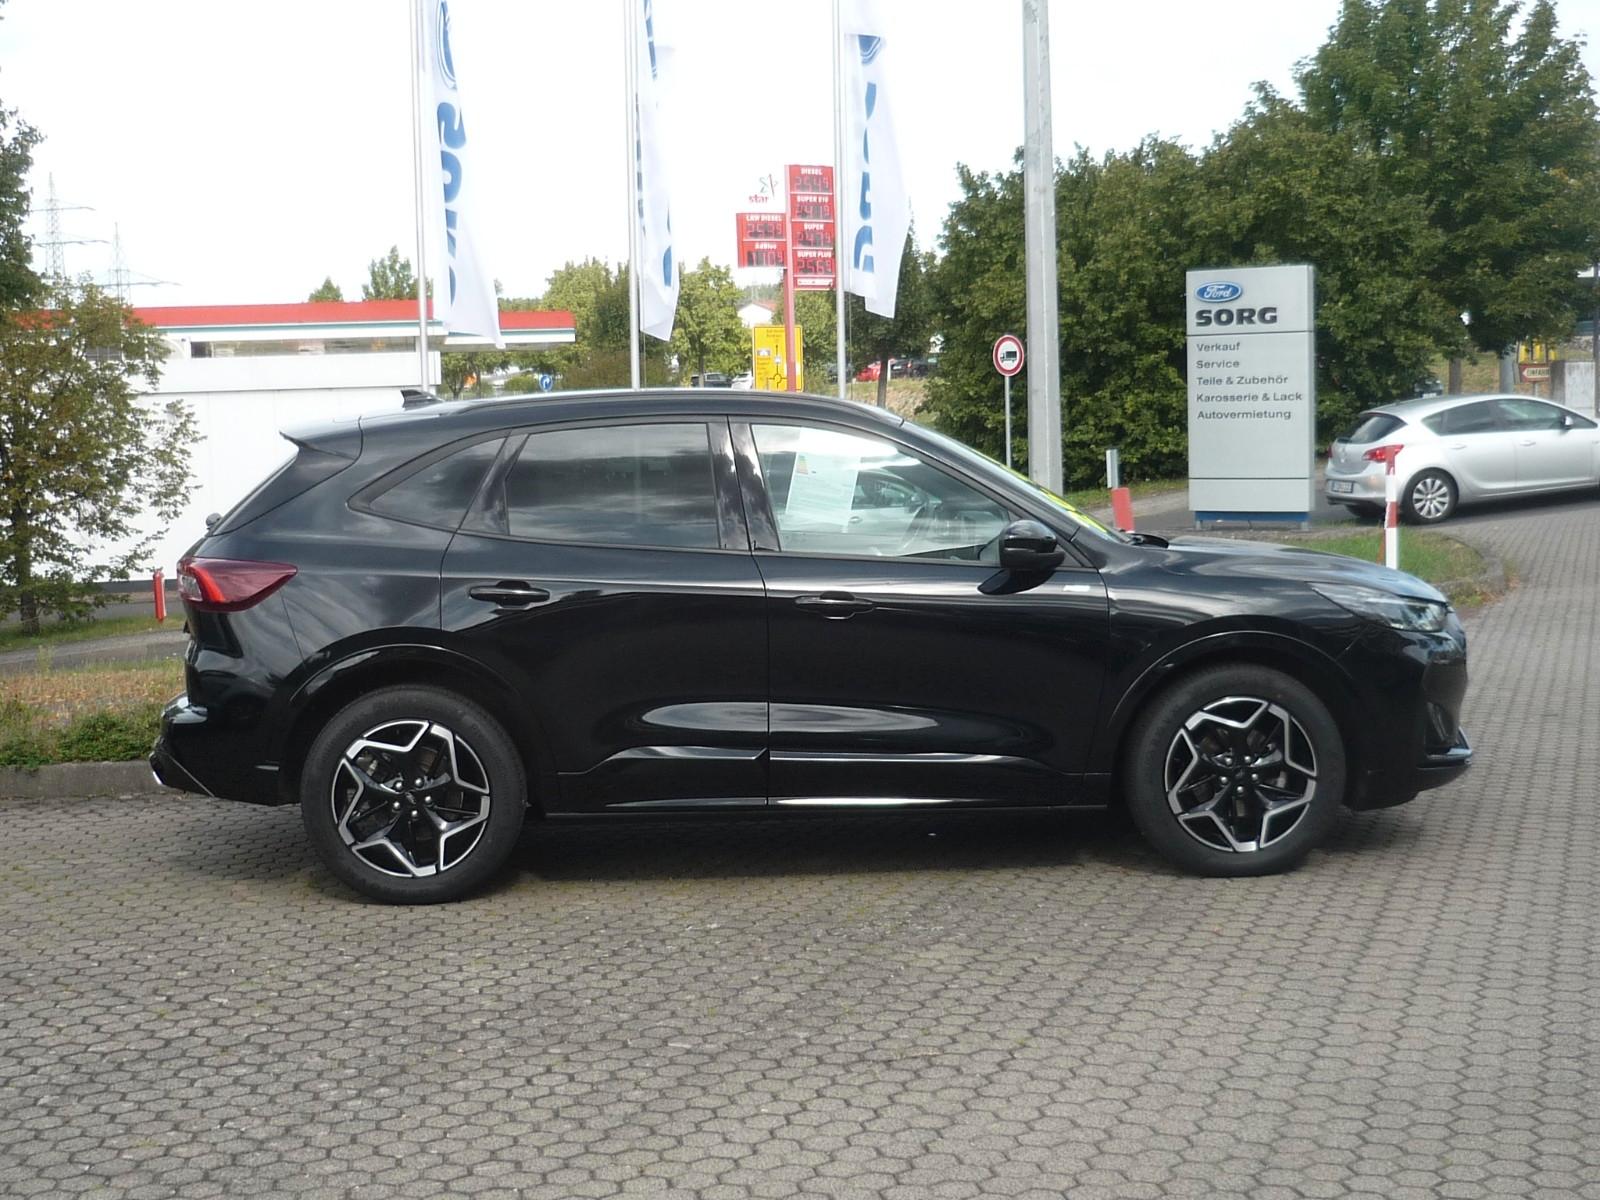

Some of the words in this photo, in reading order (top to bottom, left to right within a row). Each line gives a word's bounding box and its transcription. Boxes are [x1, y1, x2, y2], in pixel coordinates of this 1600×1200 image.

[800, 167, 823, 175] DIESEL
[748, 194, 769, 203] star
[1203, 285, 1232, 299] Ford
[1195, 307, 1278, 327] SORG
[1196, 342, 1240, 352] Verkauf
[1196, 360, 1240, 369] Service
[1196, 376, 1222, 386] Teile
[1225, 376, 1234, 385] &
[1236, 374, 1288, 385] Zubehör
[1196, 393, 1259, 403] Karosserie
[1261, 392, 1270, 401] &
[1273, 392, 1303, 401] Lack
[1197, 410, 1292, 421] Autovermietung
